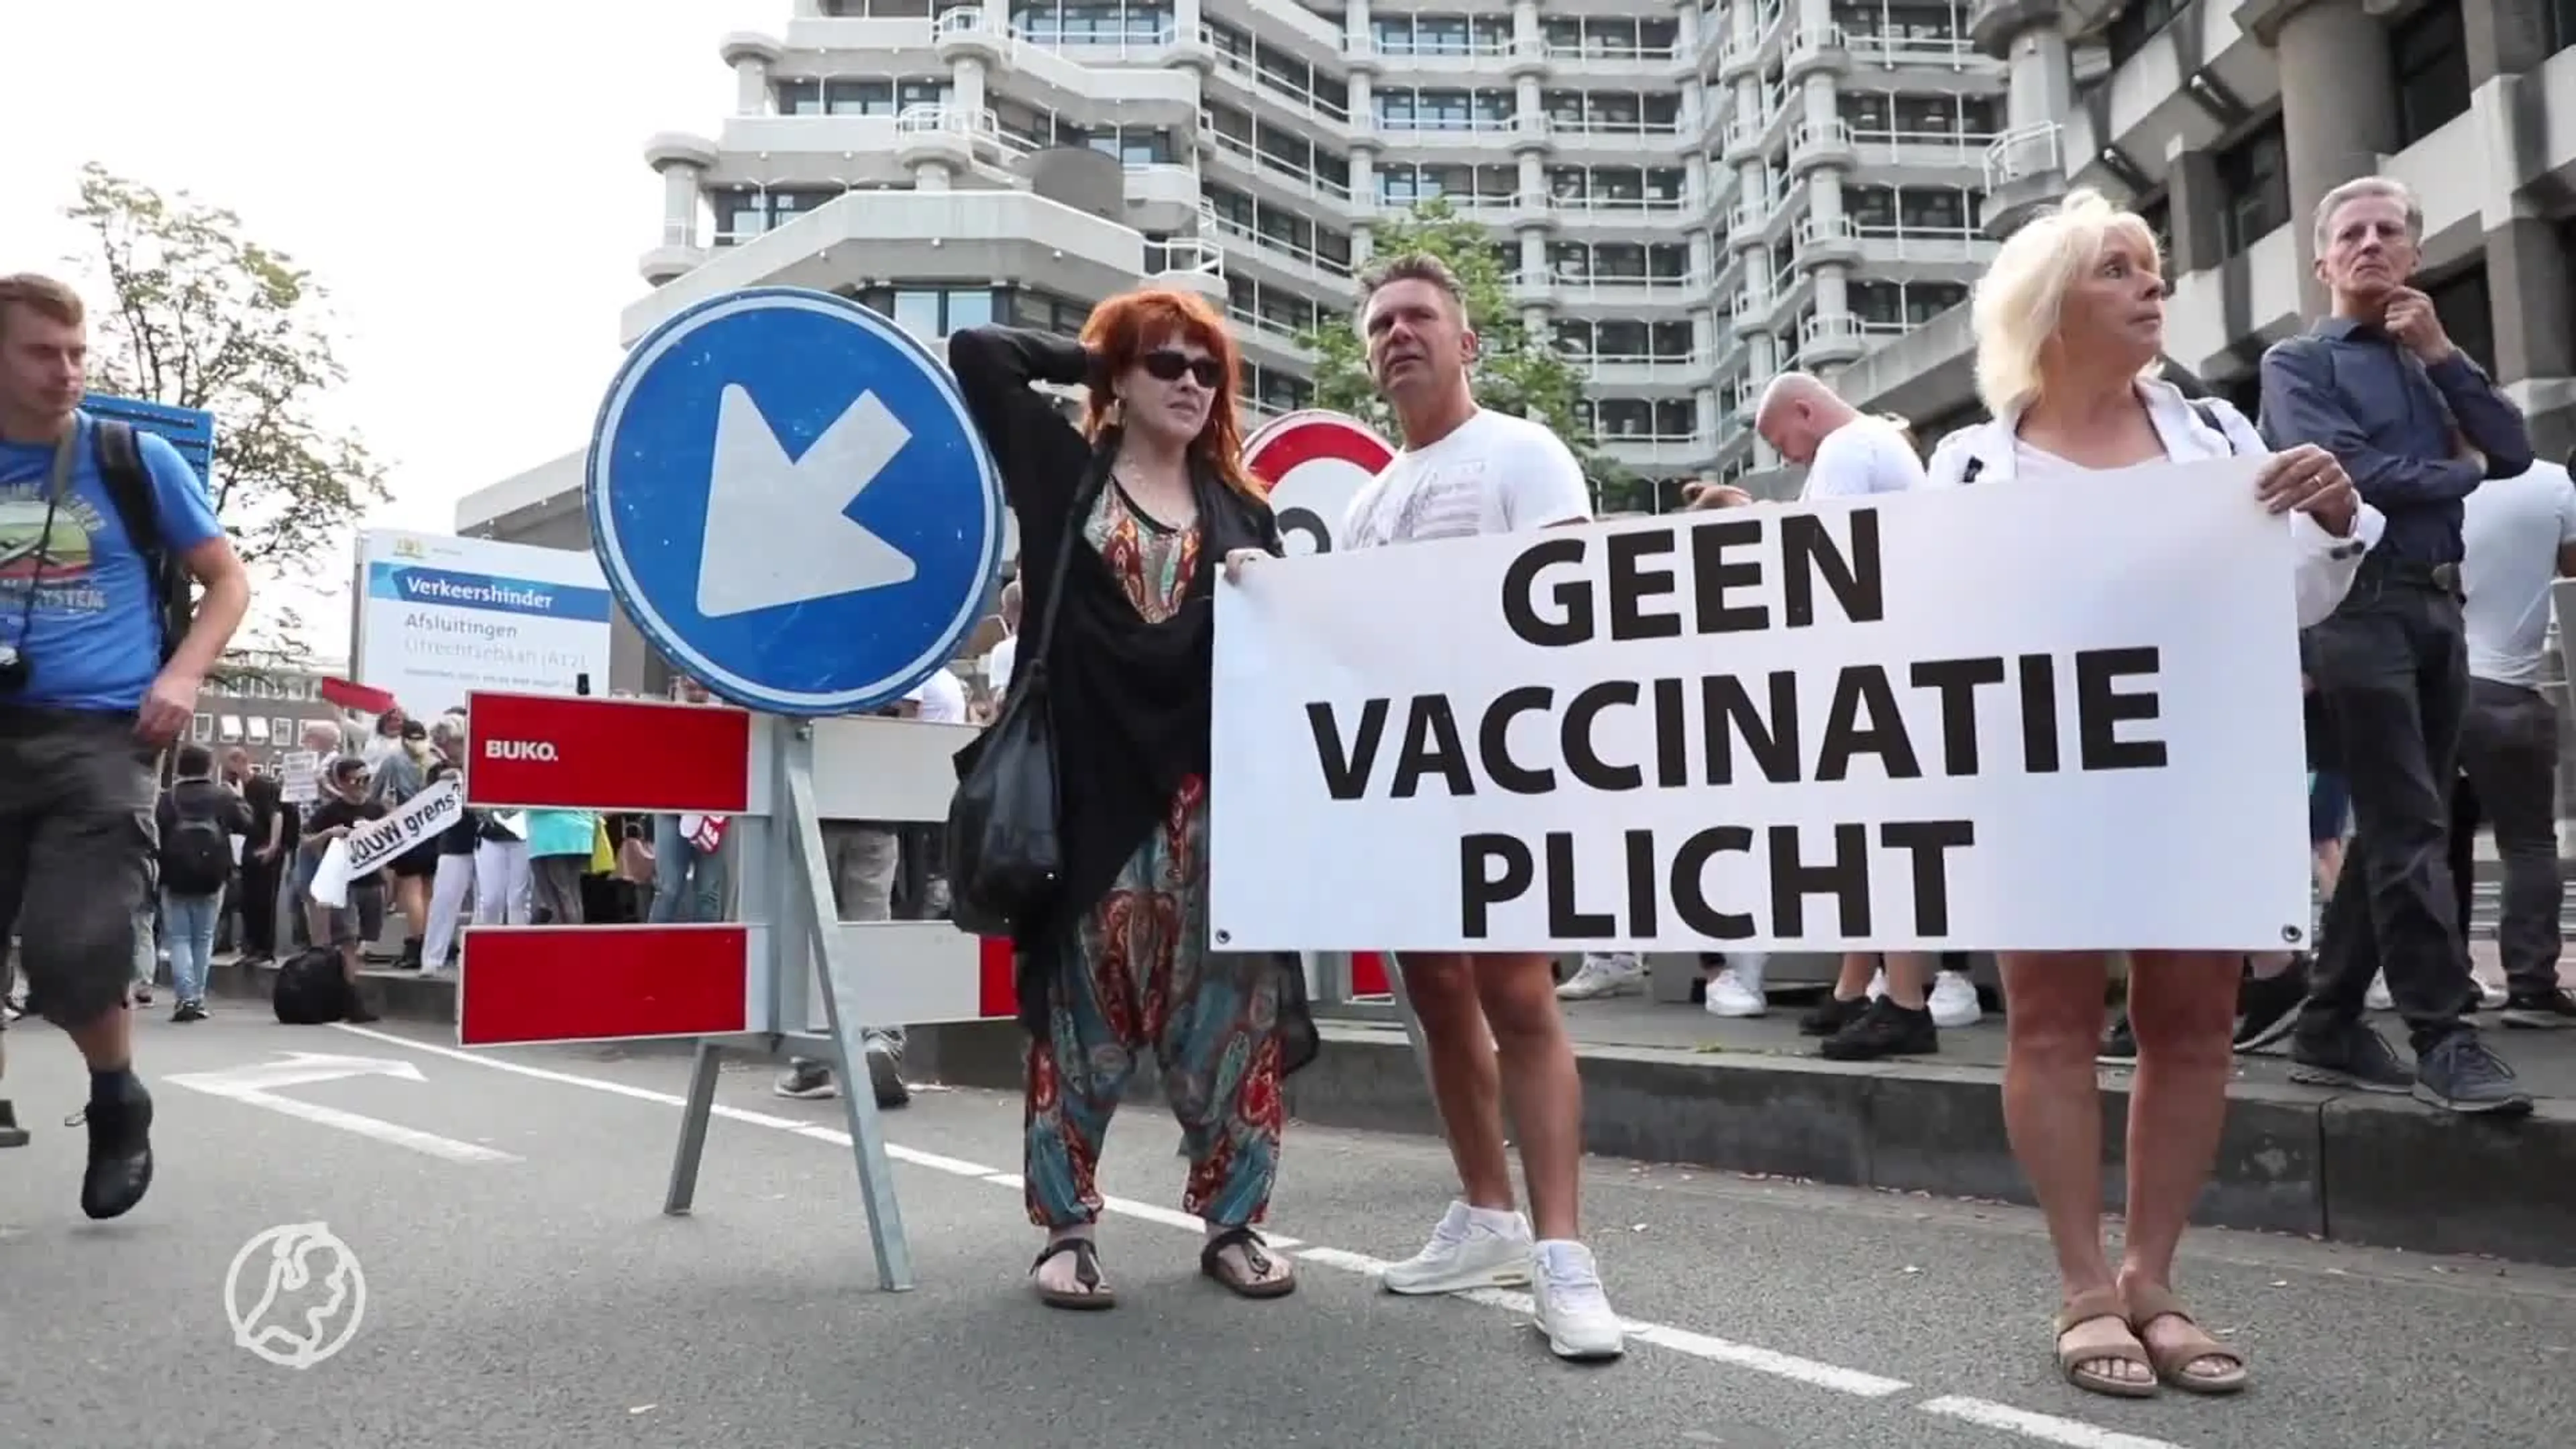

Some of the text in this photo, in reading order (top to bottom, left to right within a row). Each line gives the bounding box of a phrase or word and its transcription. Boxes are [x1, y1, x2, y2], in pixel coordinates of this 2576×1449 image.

[406, 575, 554, 609] Verkeershinder
[1501, 507, 1884, 647] GEEN
[405, 612, 518, 641] Afsluitingen
[485, 739, 559, 761] BUKO.
[1305, 645, 2168, 800] VACCINATIE
[1460, 819, 1975, 941] PLICHT
